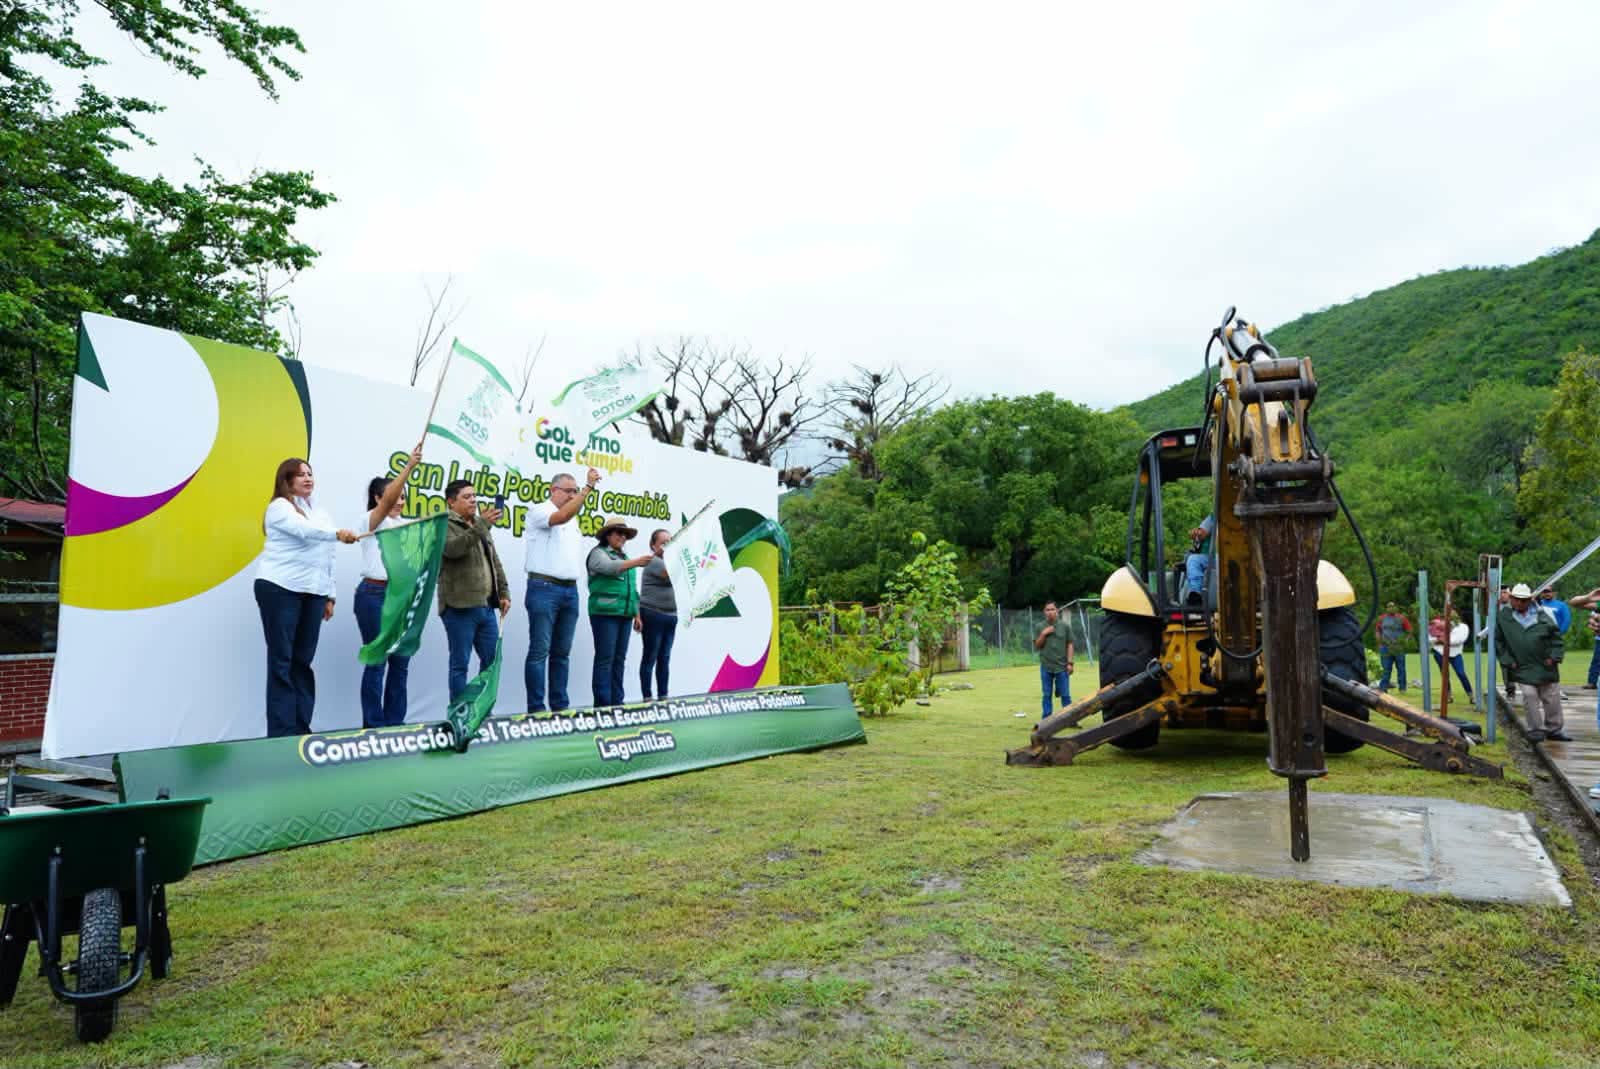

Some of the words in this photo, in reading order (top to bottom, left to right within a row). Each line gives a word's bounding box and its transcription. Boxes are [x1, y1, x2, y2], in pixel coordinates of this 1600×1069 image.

[535, 442, 572, 464] que
[576, 451, 633, 475] cumple
[386, 451, 444, 491] San
[602, 491, 671, 520] cambió.
[499, 715, 573, 741] Techado
[574, 712, 596, 731] de
[597, 711, 613, 727] la
[614, 702, 669, 724] Escuela
[670, 699, 721, 720] Primaria
[721, 695, 760, 714] Héroes
[760, 692, 805, 710] Potosinos
[599, 731, 674, 760] Lagunillas
